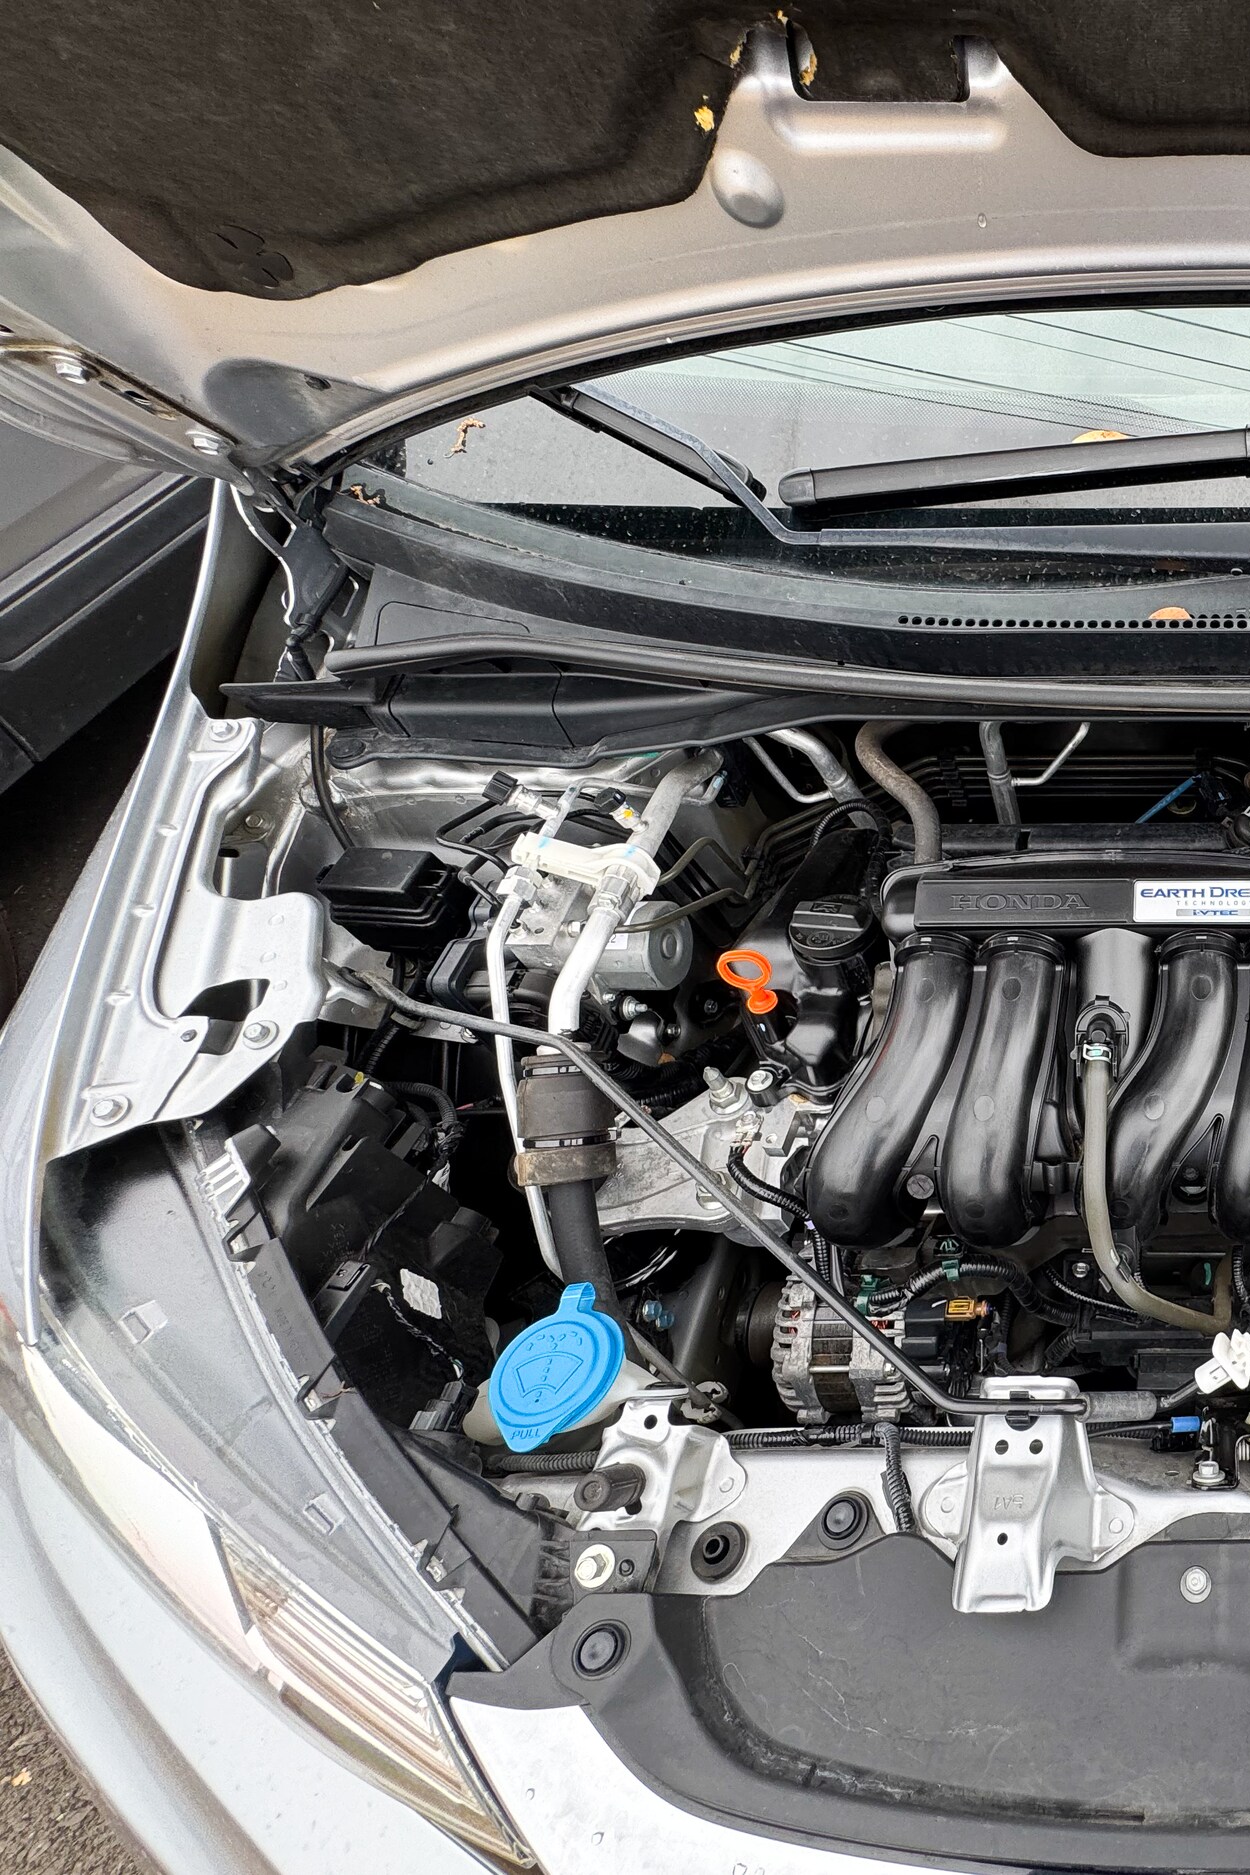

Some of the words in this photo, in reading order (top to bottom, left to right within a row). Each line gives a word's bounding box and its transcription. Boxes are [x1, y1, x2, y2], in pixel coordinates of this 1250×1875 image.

[1140, 888, 1204, 898] EARTH
[949, 893, 1091, 911] HONDA
[511, 1428, 540, 1440] PULL
